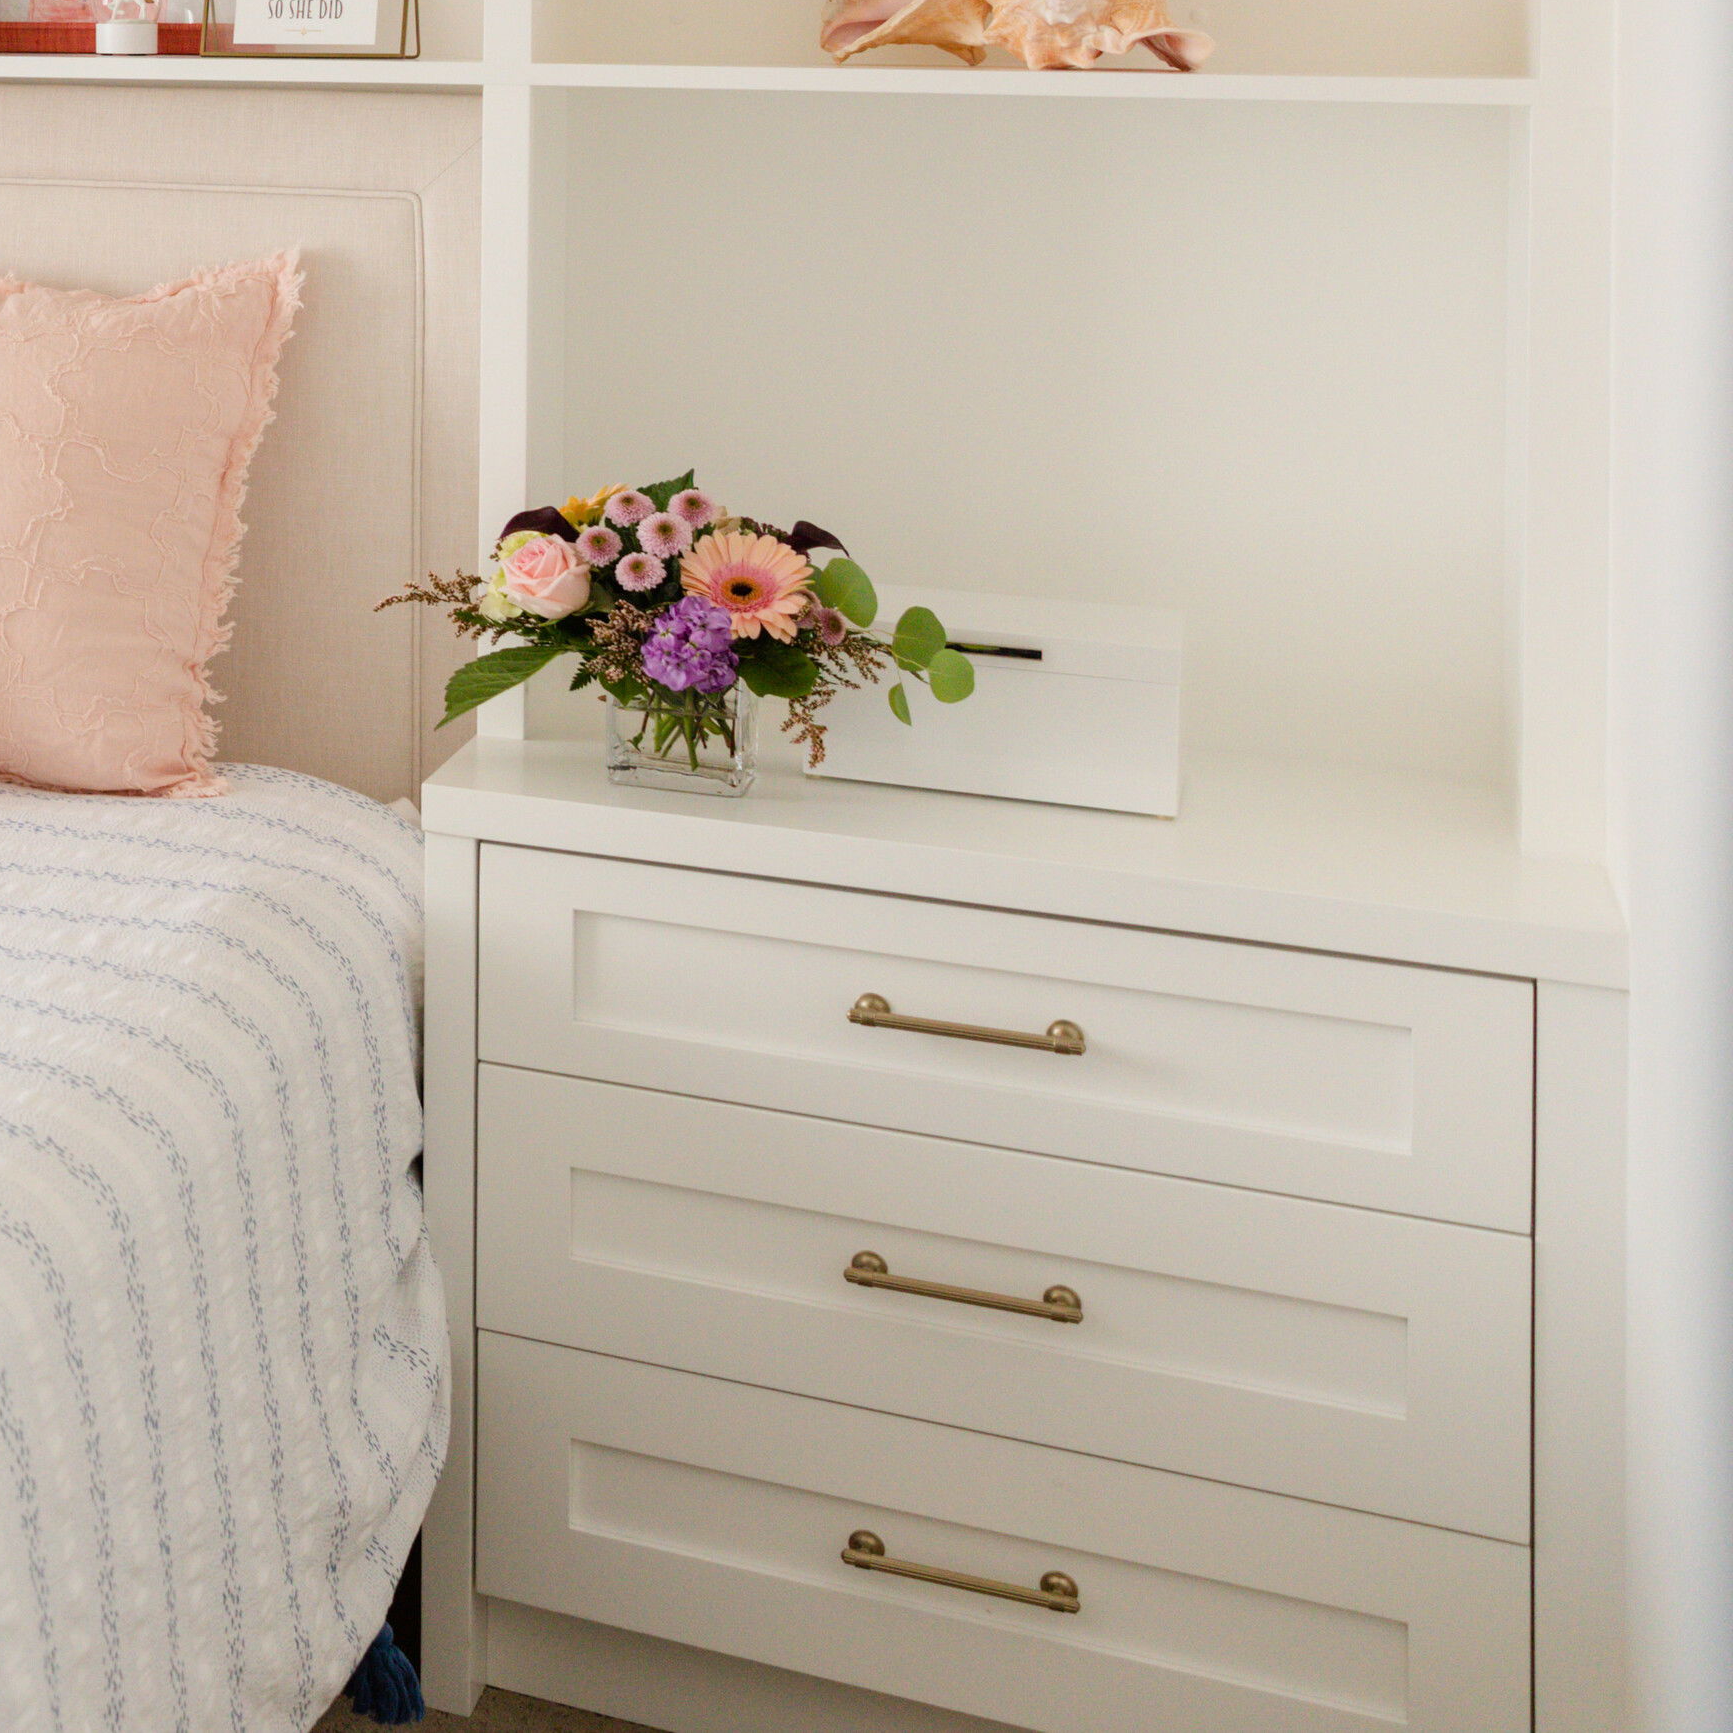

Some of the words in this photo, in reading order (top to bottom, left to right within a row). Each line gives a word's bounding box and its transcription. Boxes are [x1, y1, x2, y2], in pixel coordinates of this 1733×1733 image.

[268, 0, 283, 19] SO
[289, 0, 313, 19] SHE
[319, 0, 343, 19] DID
